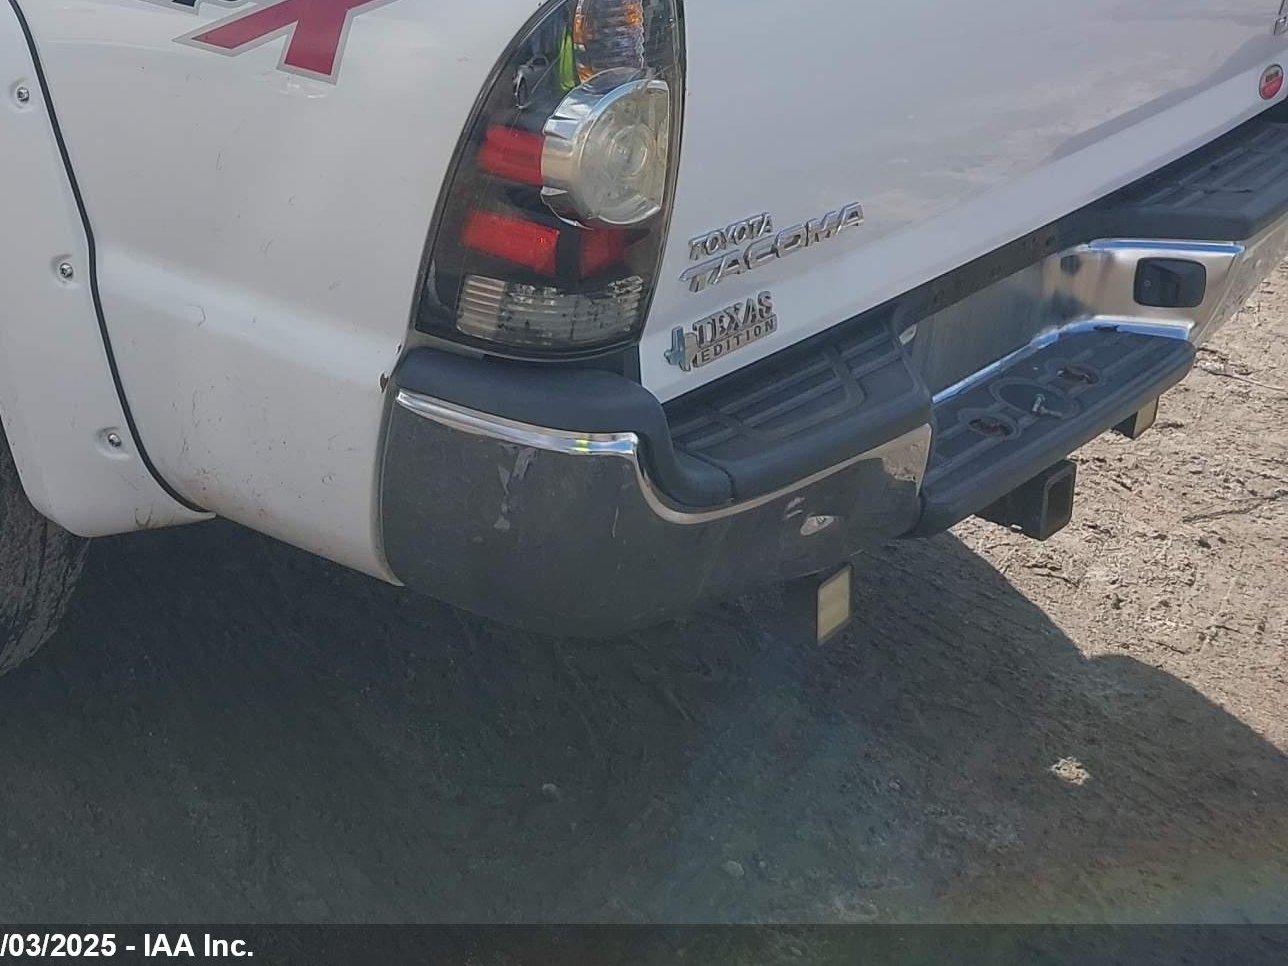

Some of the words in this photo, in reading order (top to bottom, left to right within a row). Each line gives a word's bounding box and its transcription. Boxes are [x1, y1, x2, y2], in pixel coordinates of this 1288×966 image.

[679, 201, 864, 293] TACOMA
[687, 212, 774, 261] TOYOTA
[692, 290, 775, 349] TEXAS
[700, 318, 775, 363] EDITION
